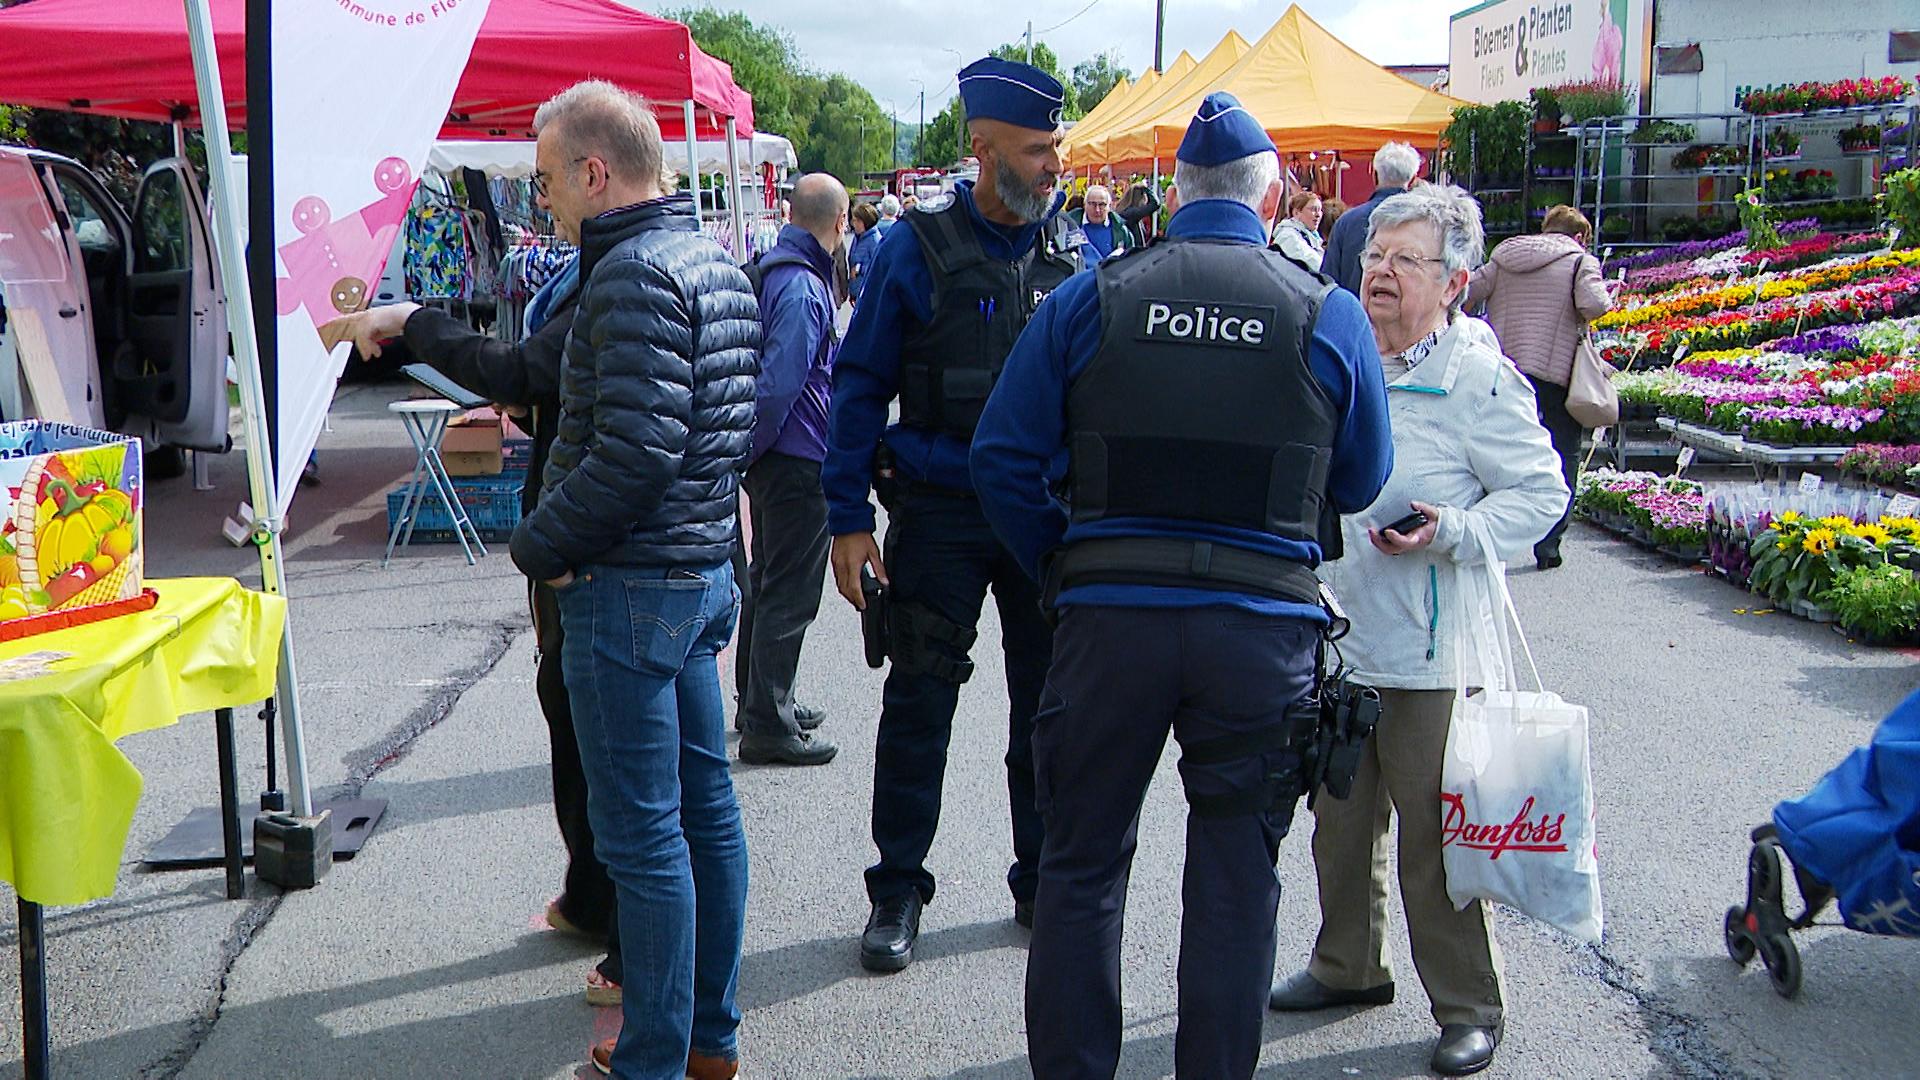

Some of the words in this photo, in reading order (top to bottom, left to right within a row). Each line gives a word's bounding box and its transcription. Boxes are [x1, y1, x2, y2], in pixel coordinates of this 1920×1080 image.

[405, 12, 425, 26] de
[1474, 23, 1514, 58] Bloemen
[1515, 15, 1528, 77] &
[1529, 2, 1572, 42] Planten
[1481, 63, 1504, 91] Fleurs
[1532, 47, 1566, 78] Plantes
[1146, 303, 1264, 344] Police
[1440, 793, 1567, 860] Danfoss
